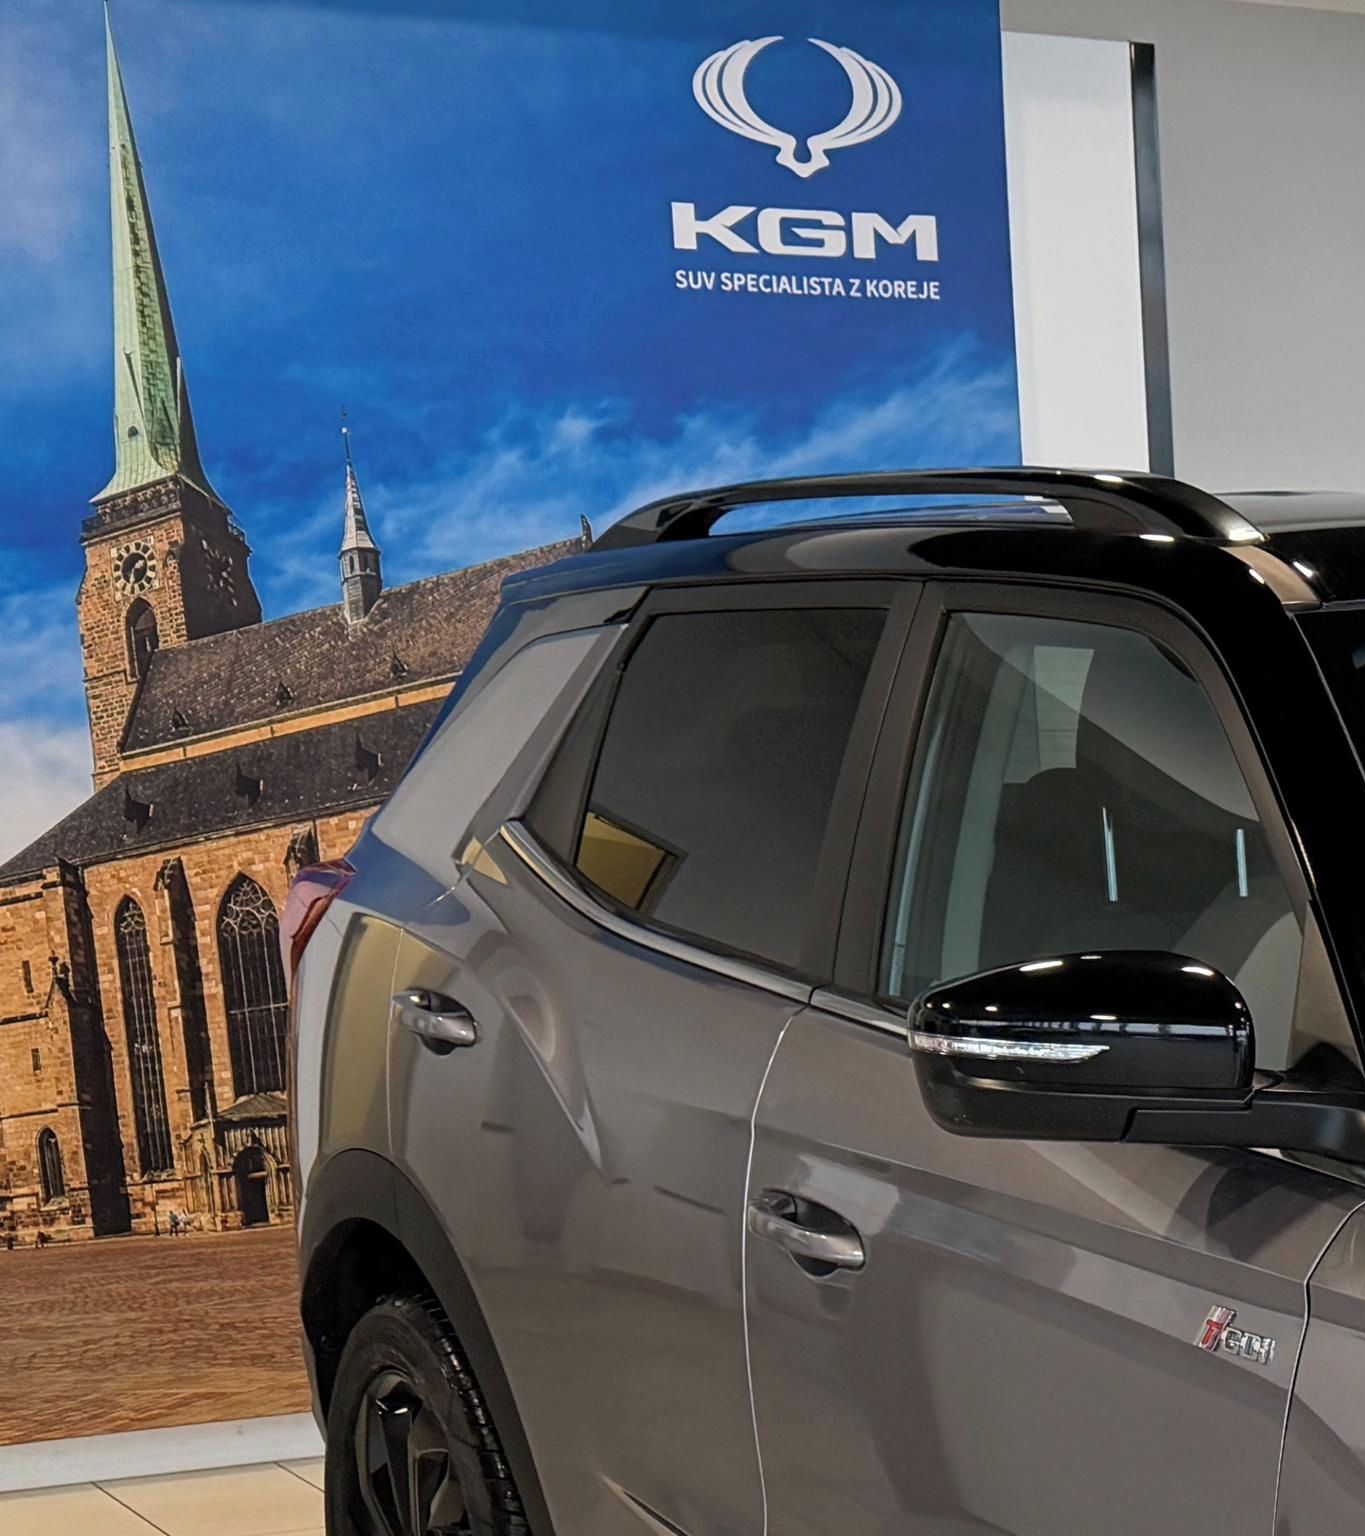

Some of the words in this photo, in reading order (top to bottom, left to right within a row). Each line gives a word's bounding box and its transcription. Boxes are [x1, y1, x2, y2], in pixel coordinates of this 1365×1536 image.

[671, 202, 939, 262] KGM
[675, 269, 716, 290] SUV
[720, 272, 846, 297] SPECIALISTA
[849, 278, 862, 297] Z
[866, 279, 941, 300] KOREJE
